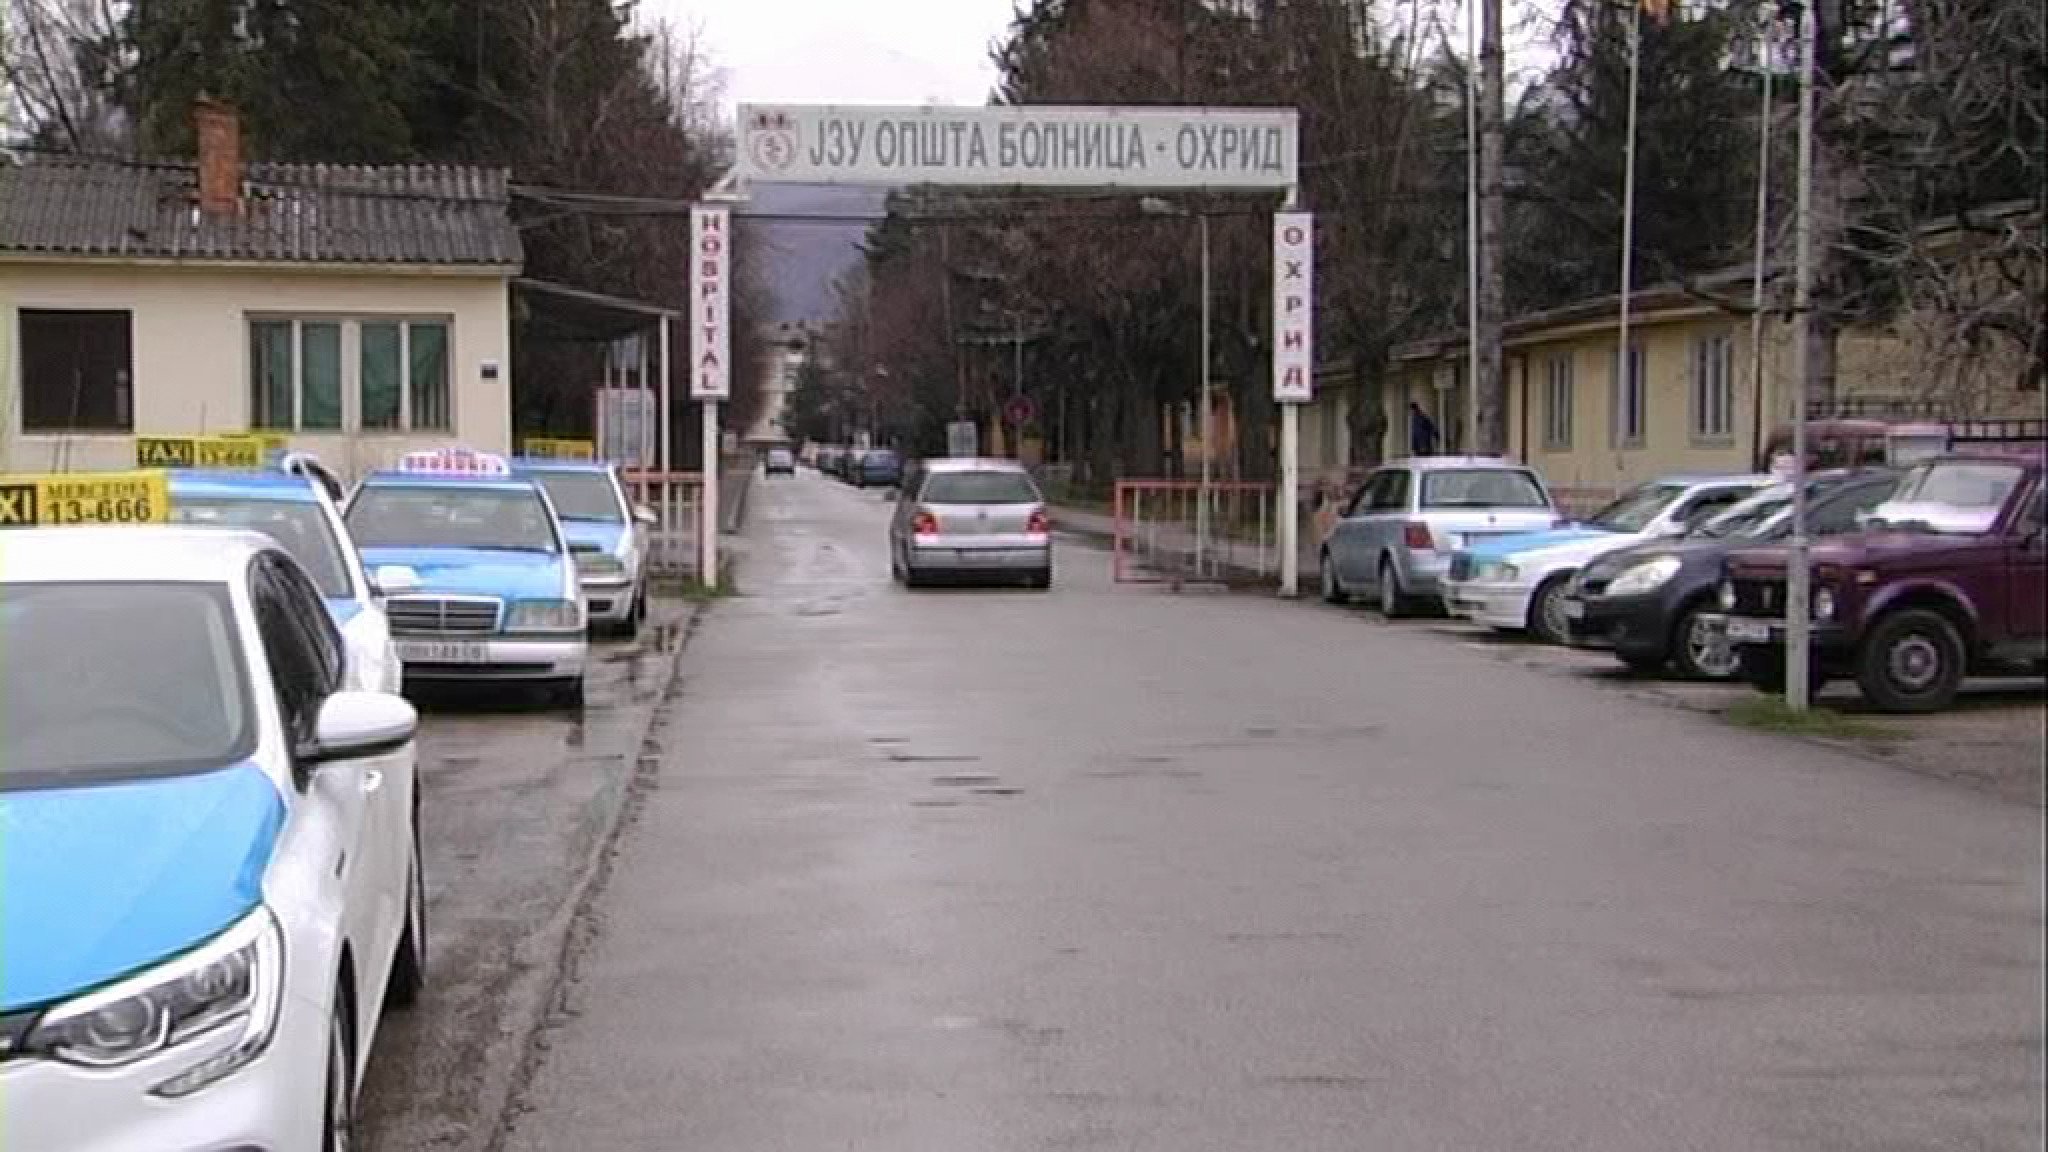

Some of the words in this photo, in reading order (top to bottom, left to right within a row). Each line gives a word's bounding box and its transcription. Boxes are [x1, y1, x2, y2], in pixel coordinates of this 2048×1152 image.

[874, 119, 988, 168] ОПШТА
[1000, 121, 1147, 171] БОЛНИЦА
[1177, 124, 1282, 172] ОХРИД
[701, 213, 720, 390] HOSPITAL
[1283, 226, 1304, 388] ОХРИД
[141, 442, 190, 462] TAXI
[47, 481, 150, 498] MERCEDES
[47, 499, 152, 525] 13-666
